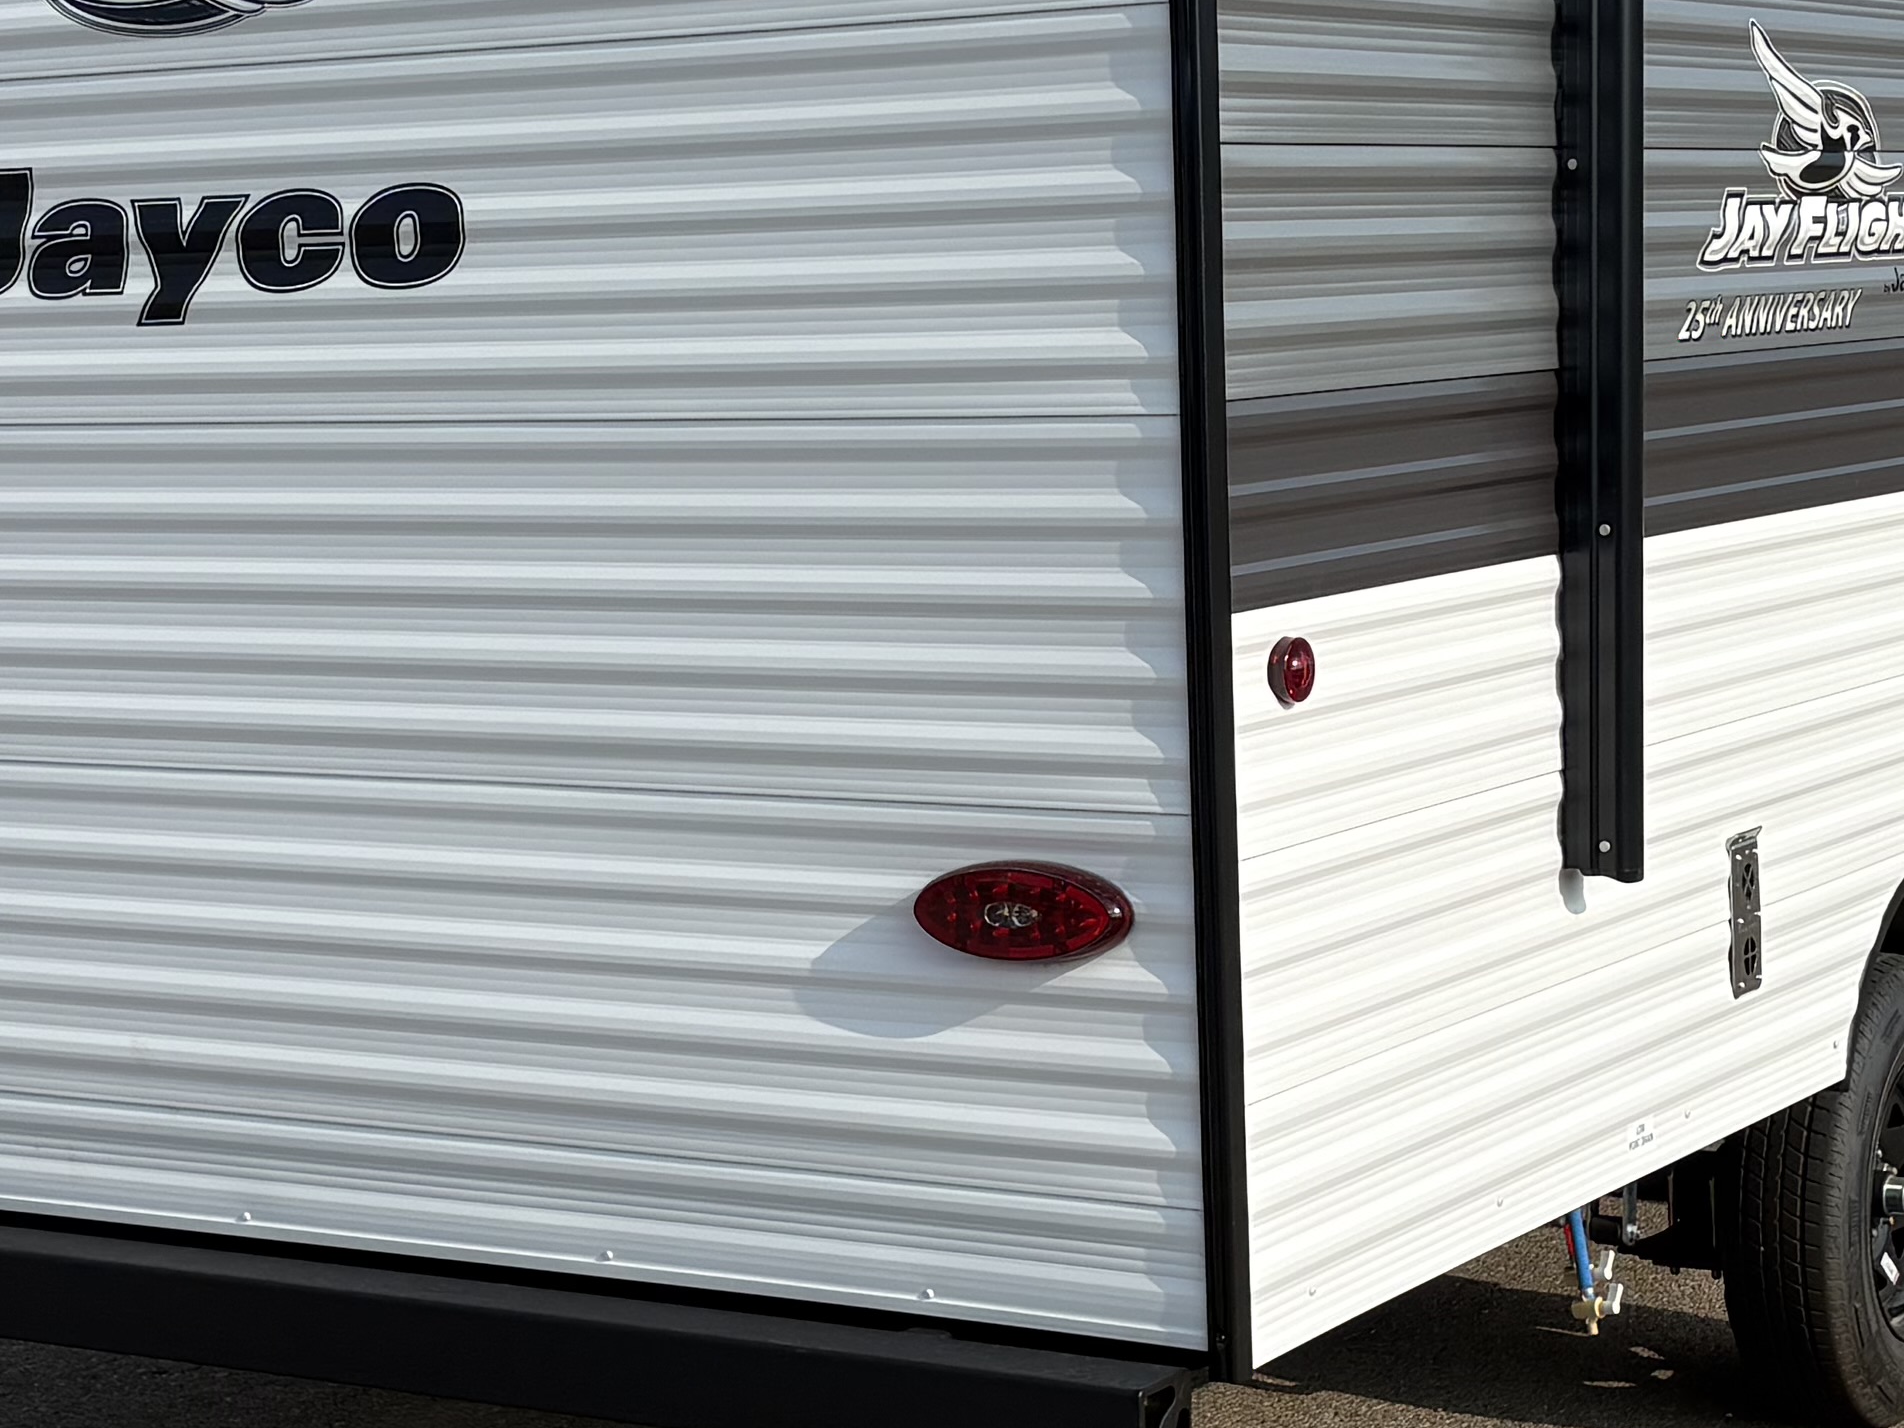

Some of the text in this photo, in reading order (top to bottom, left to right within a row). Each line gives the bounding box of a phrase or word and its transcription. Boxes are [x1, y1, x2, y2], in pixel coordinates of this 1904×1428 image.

[1697, 187, 1800, 272] JAY
[1677, 288, 1863, 342] 25th ANNIVERSARY
